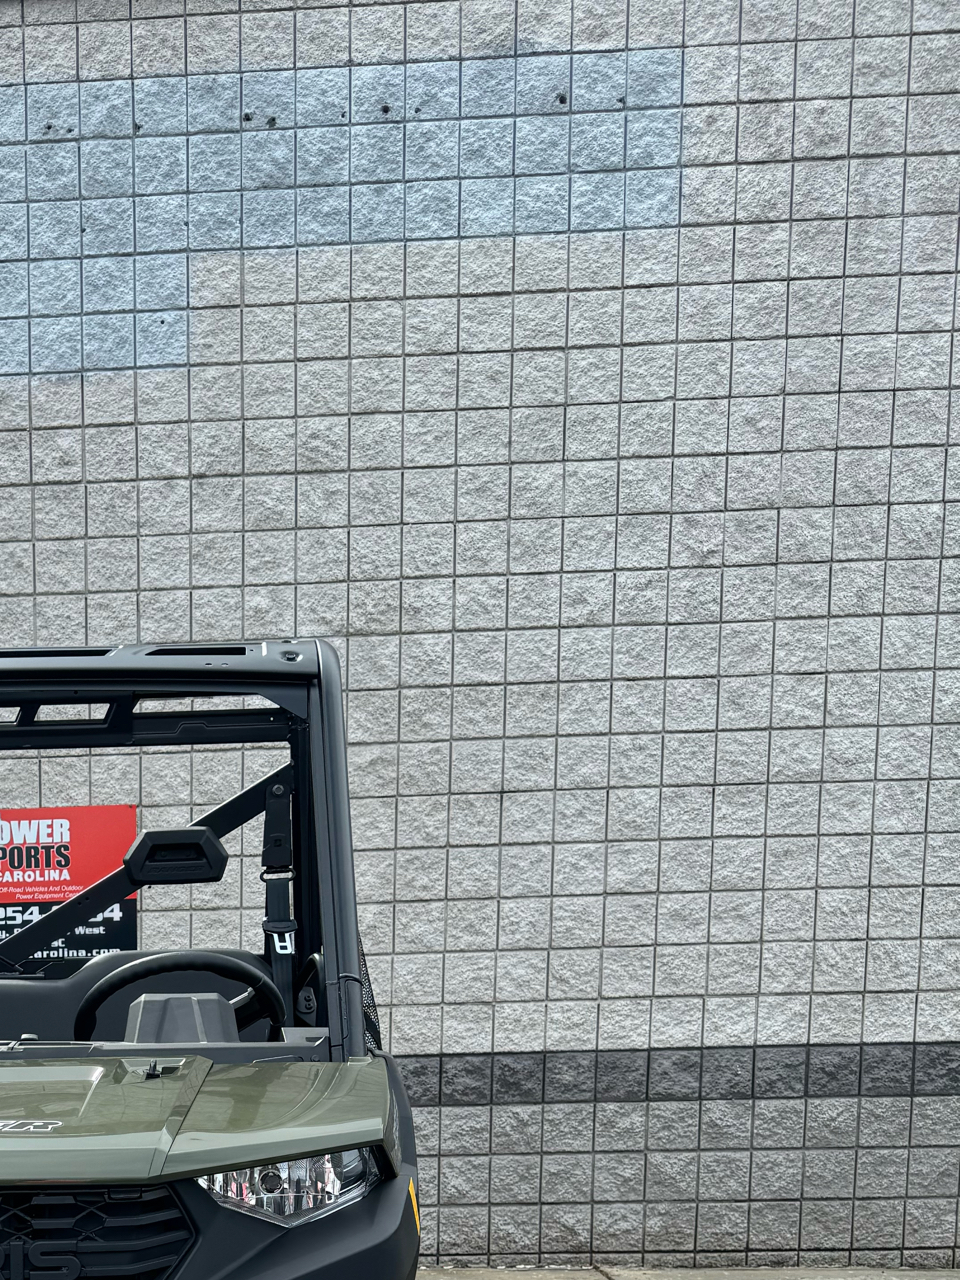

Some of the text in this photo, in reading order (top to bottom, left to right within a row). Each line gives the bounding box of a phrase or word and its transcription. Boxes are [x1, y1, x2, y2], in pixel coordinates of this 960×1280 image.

[0, 885, 24, 894] Off-Road
[25, 885, 48, 893] Vehicles
[61, 884, 84, 892] Outdoor
[16, 893, 34, 902] Power
[35, 892, 64, 902] Equipment
[74, 925, 106, 935] West
